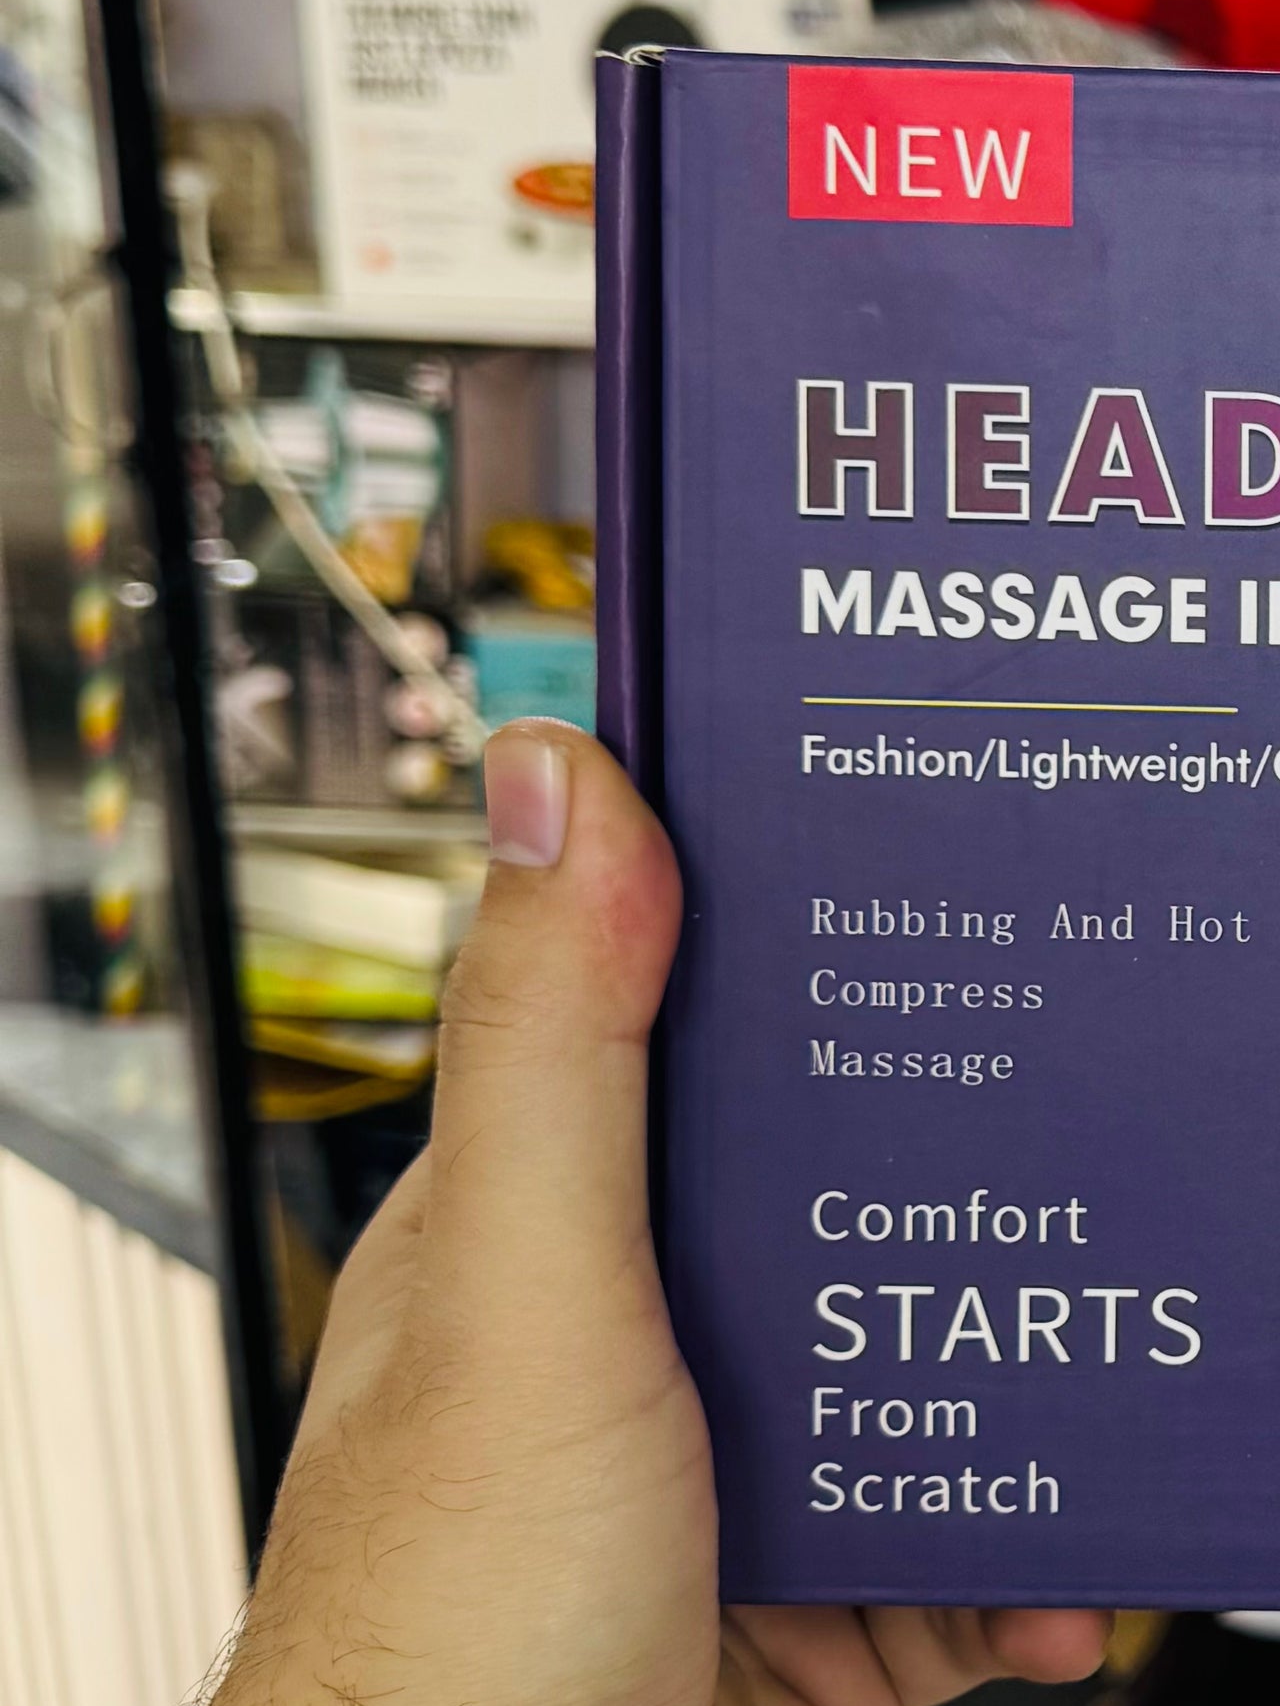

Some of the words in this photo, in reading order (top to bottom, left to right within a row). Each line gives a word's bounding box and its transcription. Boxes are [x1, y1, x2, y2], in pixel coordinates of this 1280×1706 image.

[823, 124, 1031, 201] NEW
[800, 567, 1208, 644] MASSAGE
[810, 898, 1018, 946] Rubbing
[1049, 902, 1135, 941] And
[1168, 904, 1252, 944] Hot
[809, 968, 1045, 1015] Compress
[809, 1039, 1015, 1086] Massage
[811, 1188, 1089, 1245] Comfort
[811, 1282, 1203, 1366] STARTS
[812, 1386, 978, 1438] From
[809, 1460, 1061, 1515] Scratch
